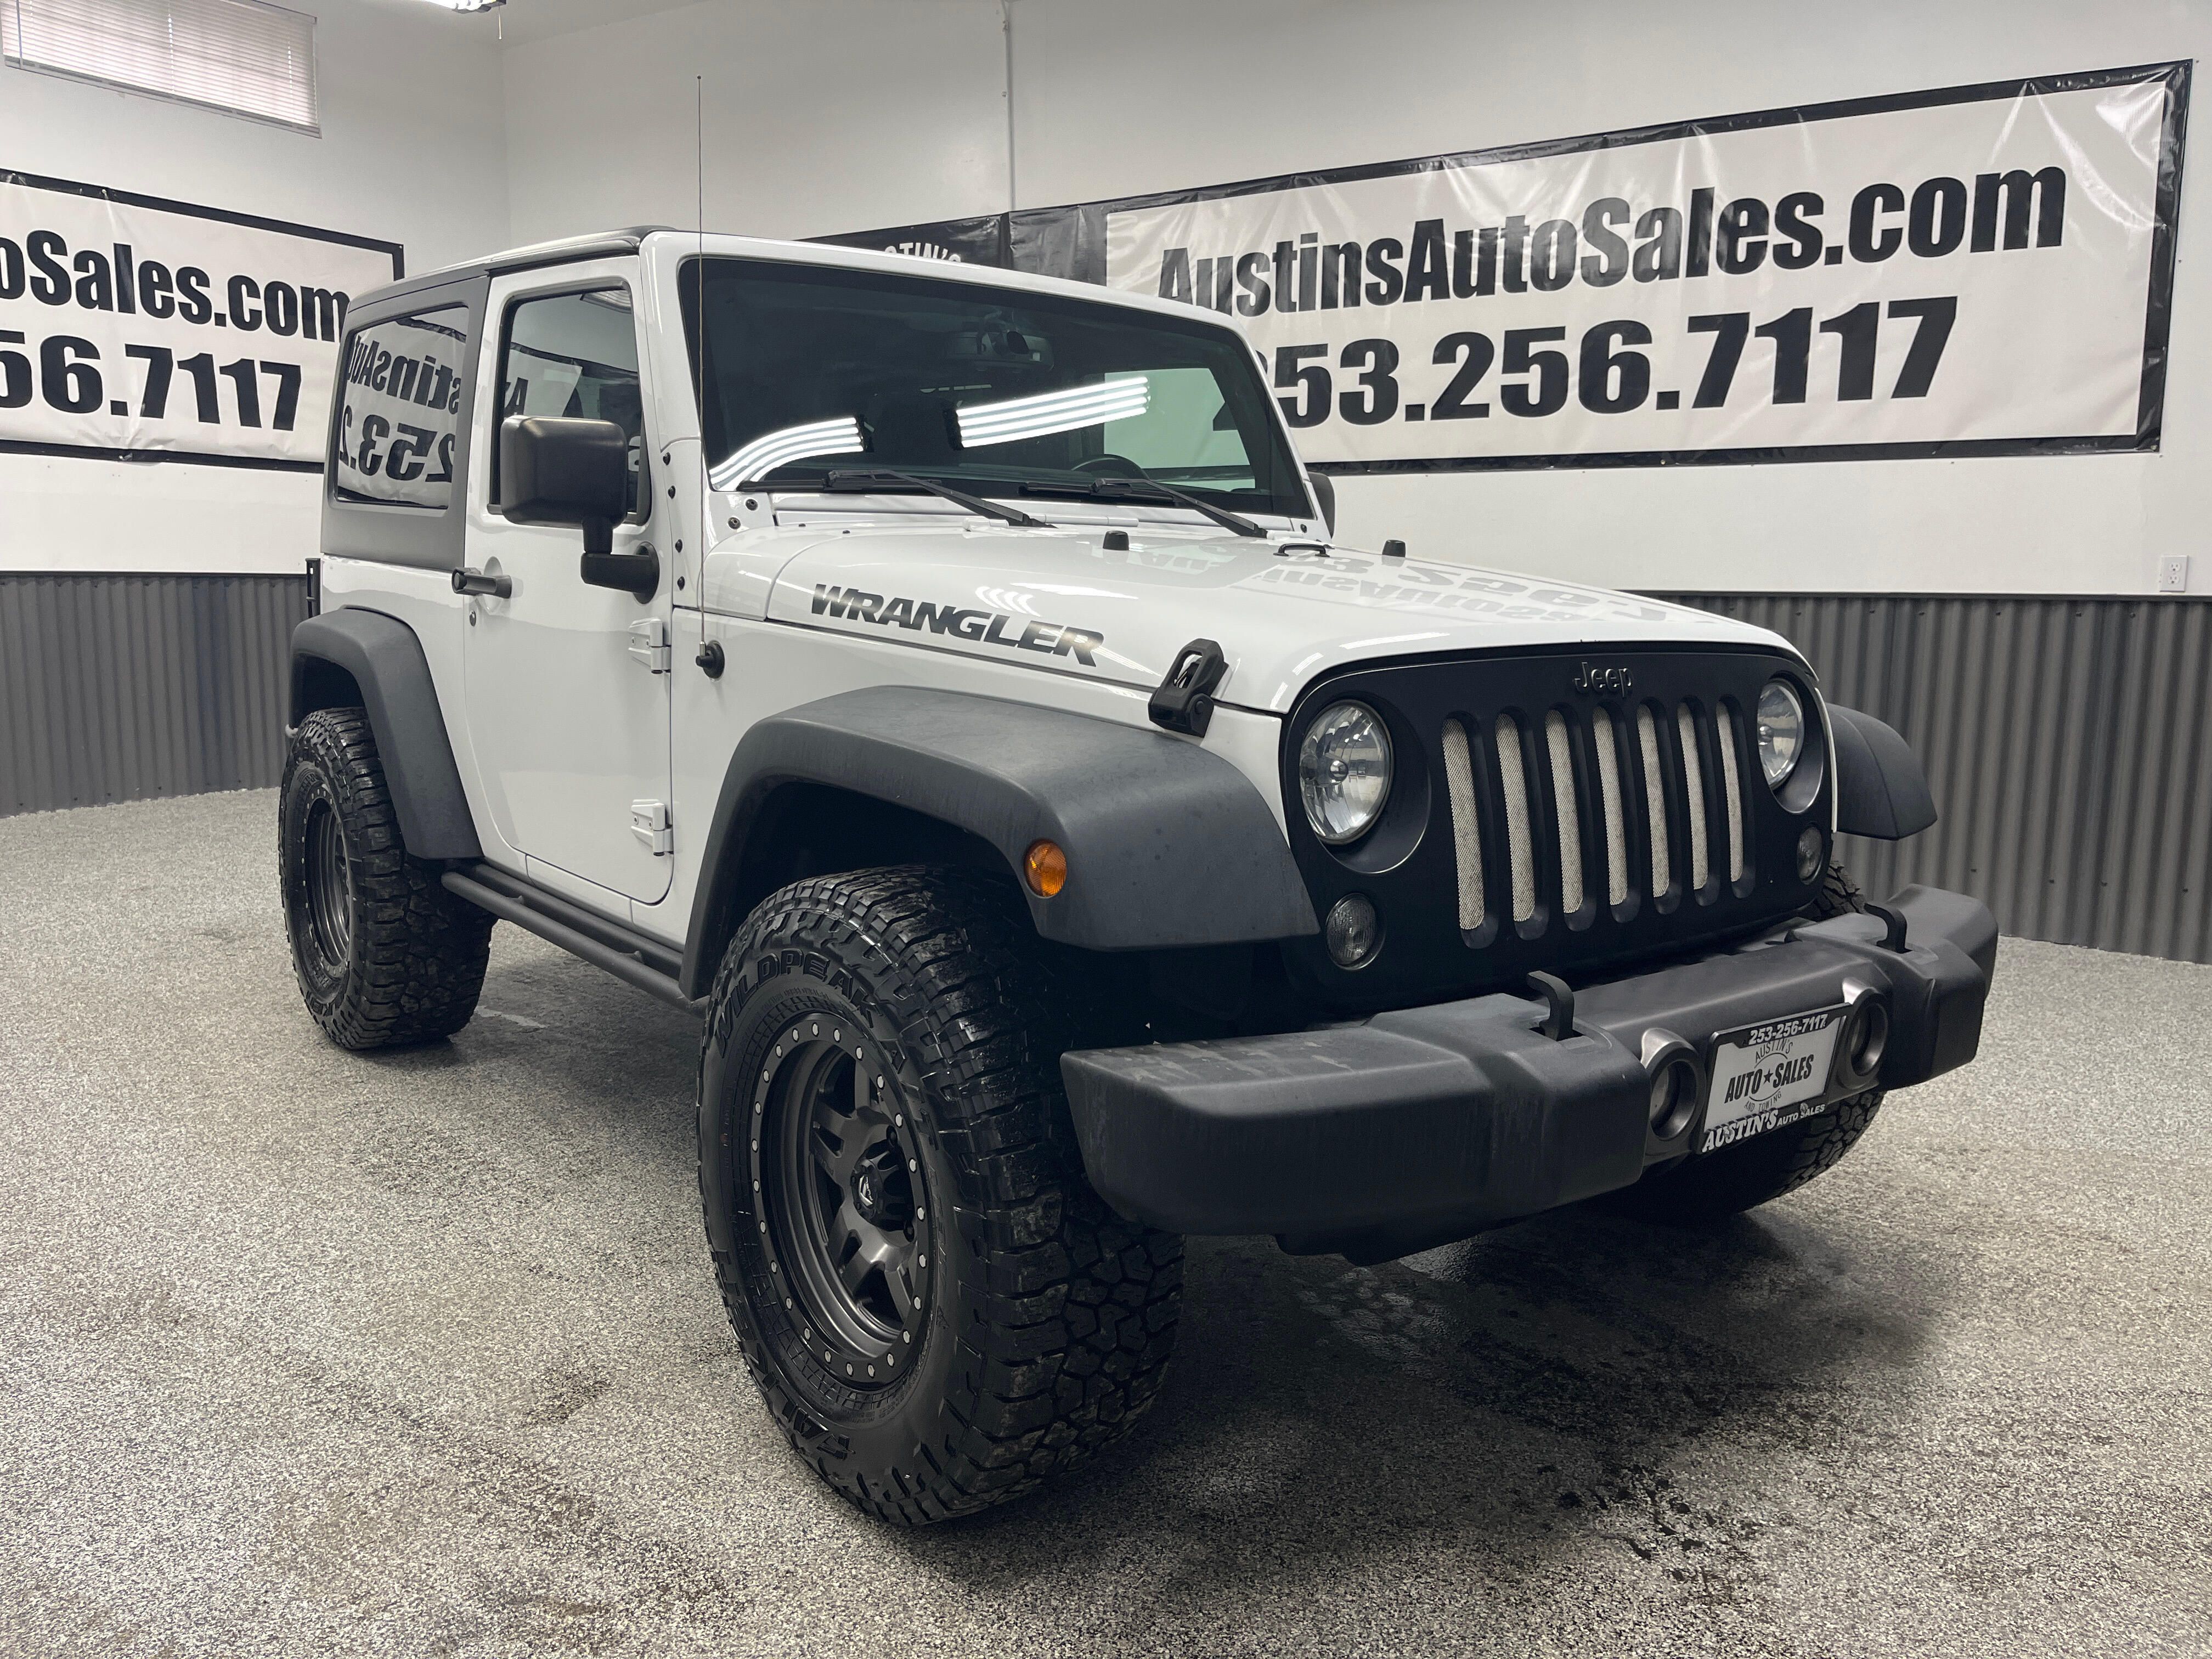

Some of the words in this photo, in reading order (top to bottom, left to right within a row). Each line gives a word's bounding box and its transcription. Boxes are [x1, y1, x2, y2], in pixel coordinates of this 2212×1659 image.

[1158, 166, 2067, 317] AustinsAutoSales.com
[811, 583, 1104, 667] WRANGLER
[1572, 661, 1634, 698] Jeep
[715, 947, 883, 1058] WILDPEAK
[1748, 1013, 1829, 1045] 253-256-7117
[1756, 1038, 1793, 1063] AUSTIN'S
[1724, 1067, 1763, 1103] AUTO
[1773, 1054, 1814, 1089] SALES
[1743, 1100, 1755, 1113] AND
[1758, 1091, 1782, 1113] TOWING
[1702, 1109, 1779, 1153] AUSTIN'S
[1777, 1112, 1799, 1126] AUTO
[1800, 1104, 1826, 1119] SALES
